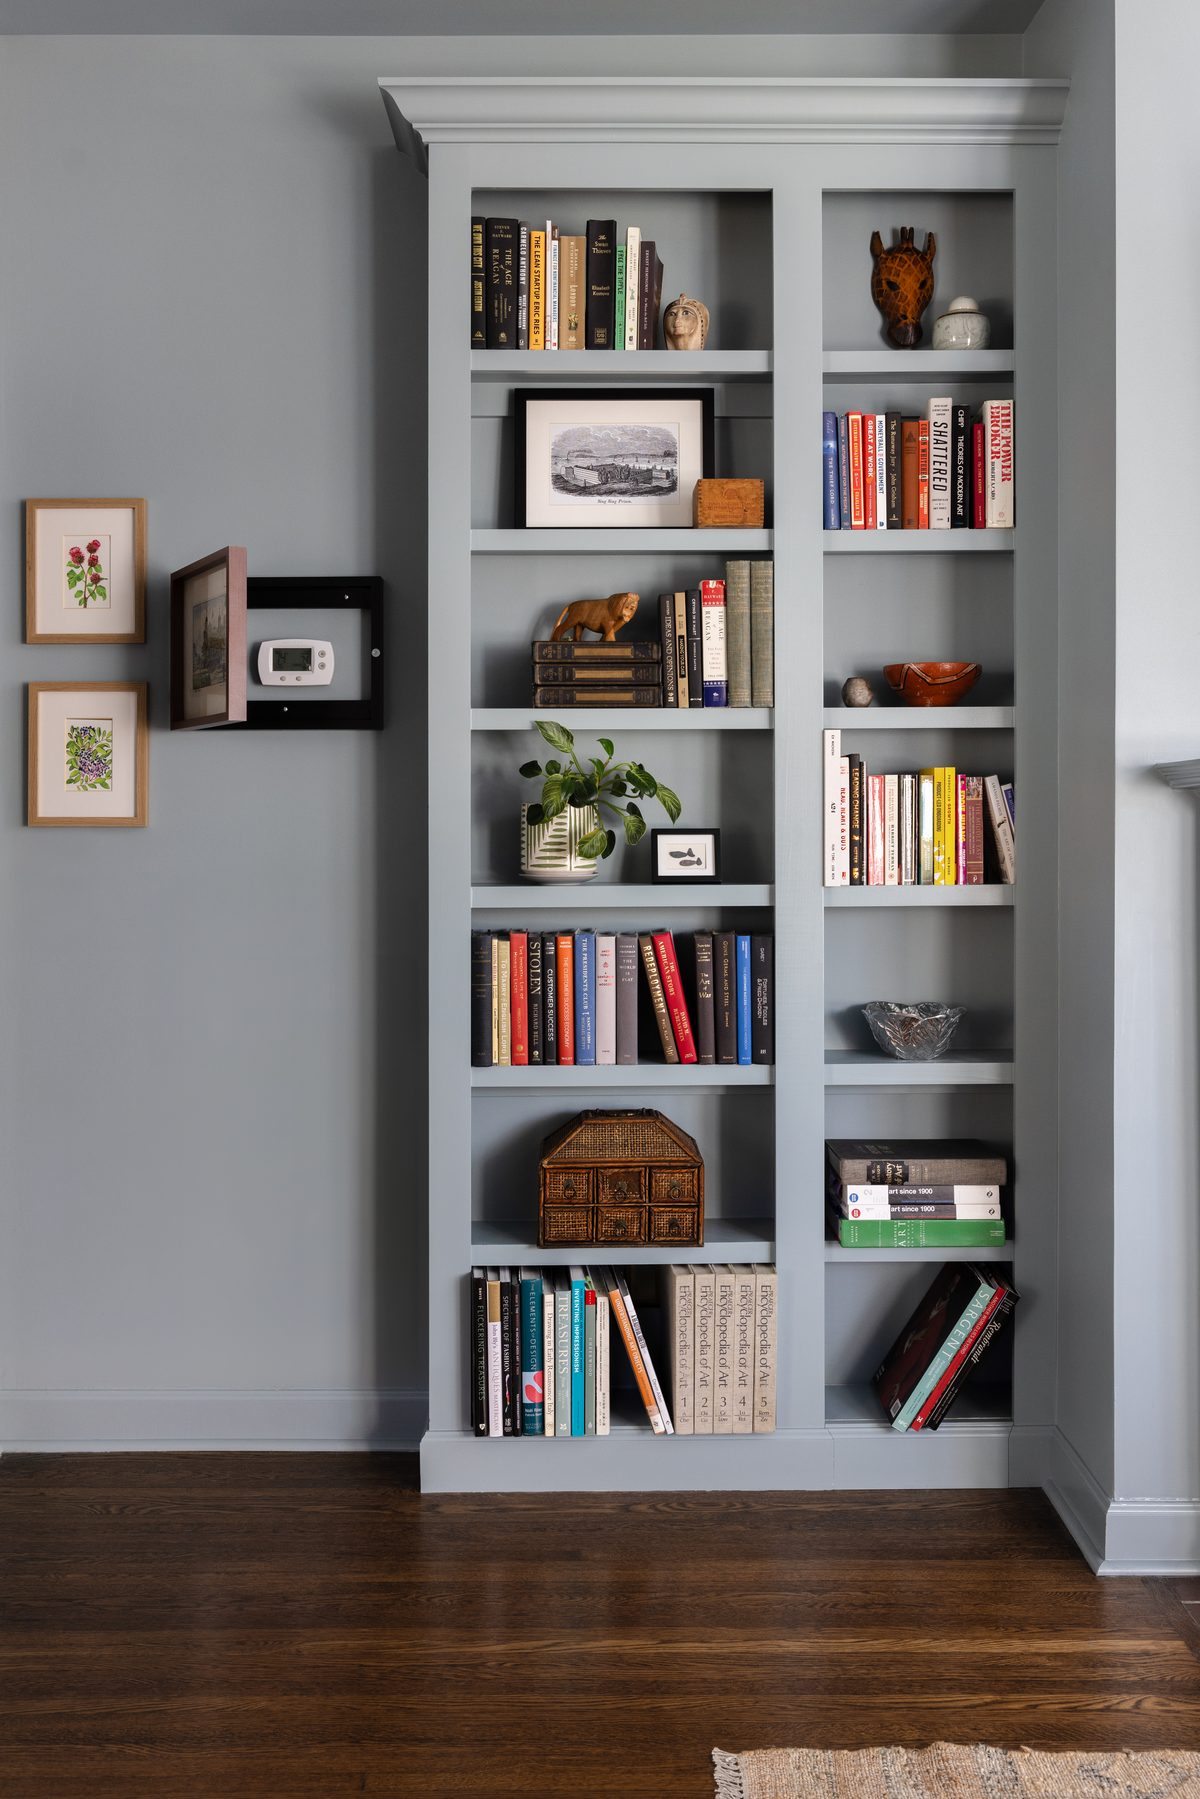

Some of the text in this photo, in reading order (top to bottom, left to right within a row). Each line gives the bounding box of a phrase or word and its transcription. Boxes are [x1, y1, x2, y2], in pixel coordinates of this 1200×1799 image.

[473, 245, 483, 256] THIS
[473, 257, 483, 268] CITY
[569, 285, 577, 306] LONDON
[868, 445, 873, 453] AT
[933, 422, 948, 491] SHATTERED
[990, 406, 1000, 460] BROKER
[1001, 403, 1011, 482] THE POWER
[957, 466, 964, 474] OF
[501, 960, 506, 968] TO
[530, 942, 541, 994] STOLEN
[643, 946, 665, 1013] REDEPLOYMENT
[658, 940, 675, 996] AMERICAN STORY
[503, 1333, 509, 1341] OF
[558, 1296, 568, 1374] TREASURES
[615, 1298, 631, 1341] UNDERSTANDING
[631, 1352, 642, 1373] OBJECTS
[678, 1286, 690, 1388] Encyclopedia of Art
[697, 1285, 711, 1388] Encyclopedia of Art
[716, 1285, 731, 1387] Encyclopedia of Art
[737, 1285, 751, 1387] Encyclopedia of Art
[758, 1285, 771, 1387] Encyclopedia of Art
[941, 1290, 990, 1361] SARGENT
[960, 1296, 999, 1355] ANOTHER WORLD LIES BEYOND
[970, 1321, 1001, 1363] Rembrandt
[652, 1379, 660, 1391] Devin
[682, 1397, 686, 1407] 1
[702, 1397, 708, 1407] 2
[720, 1397, 727, 1407] 3
[739, 1397, 746, 1407] 4
[761, 1397, 767, 1407] 5
[546, 1403, 554, 1415] Italy
